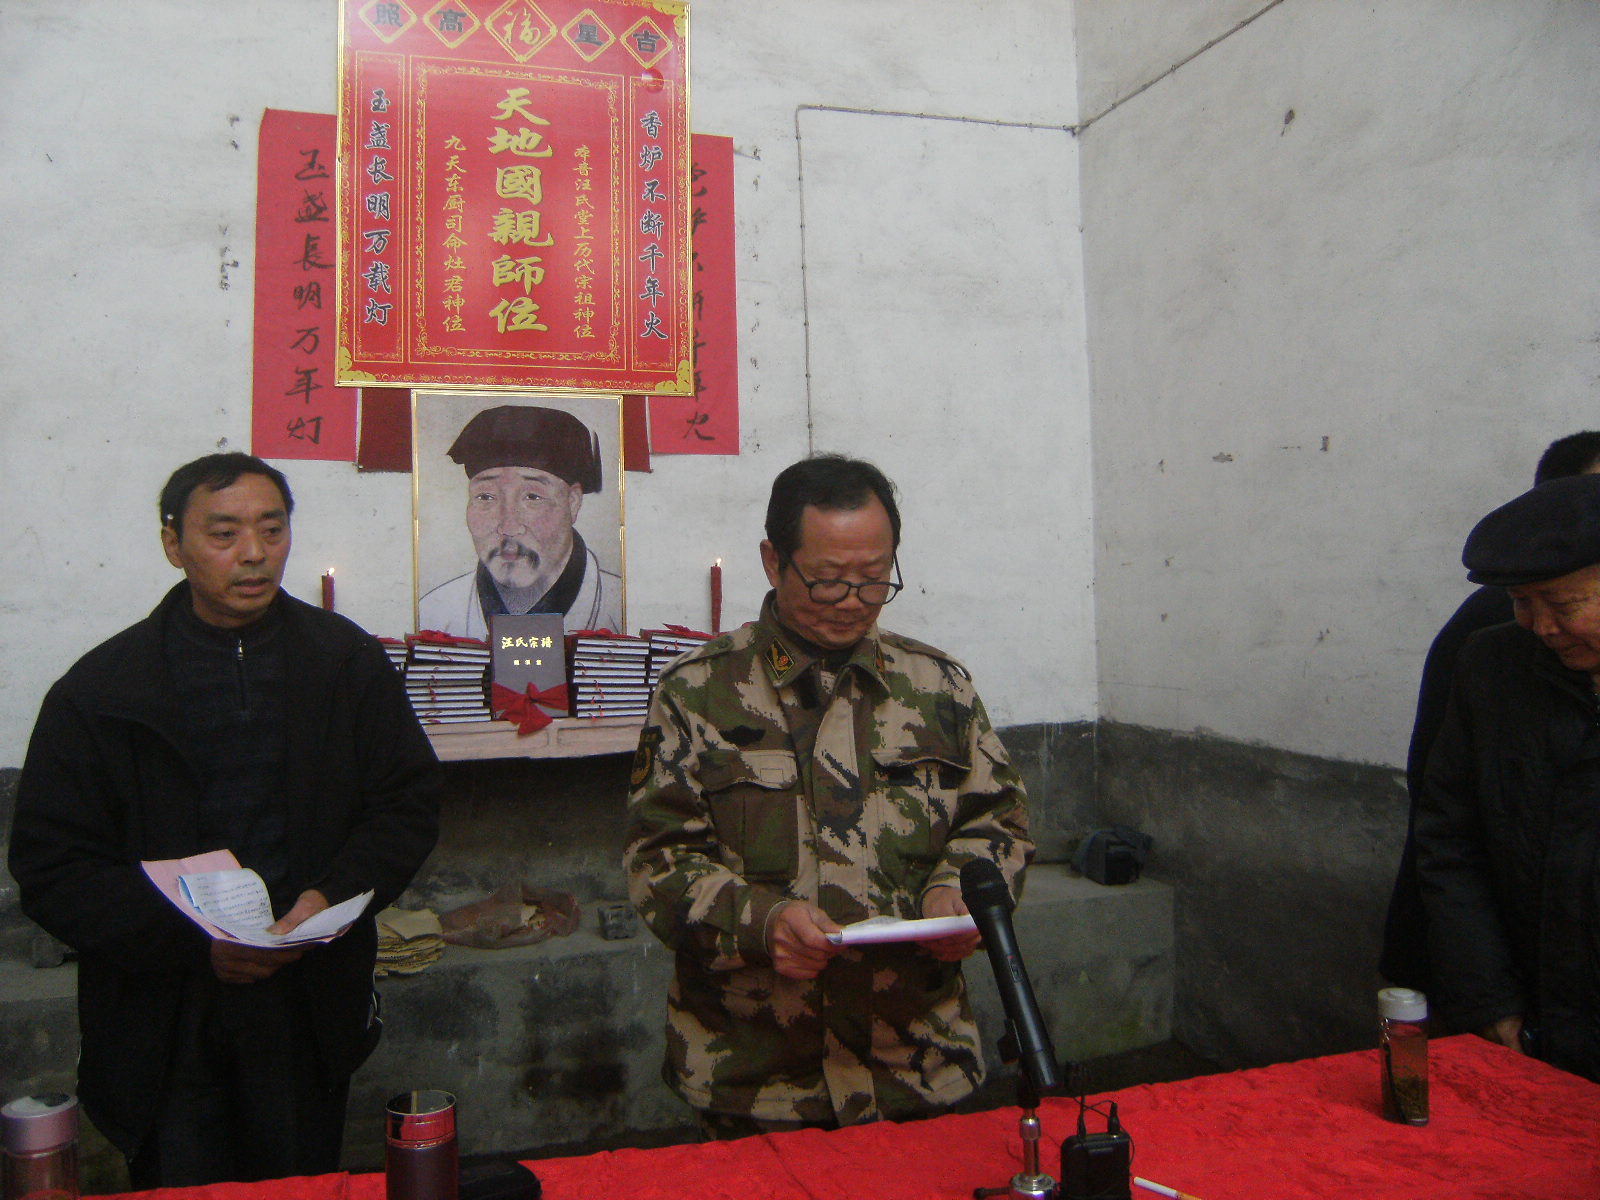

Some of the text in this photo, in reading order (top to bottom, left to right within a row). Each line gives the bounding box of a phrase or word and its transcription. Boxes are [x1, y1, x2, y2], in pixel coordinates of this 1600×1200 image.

[487, 87, 555, 334] 天地國親師位
[638, 110, 669, 340] 香炉不断千年火
